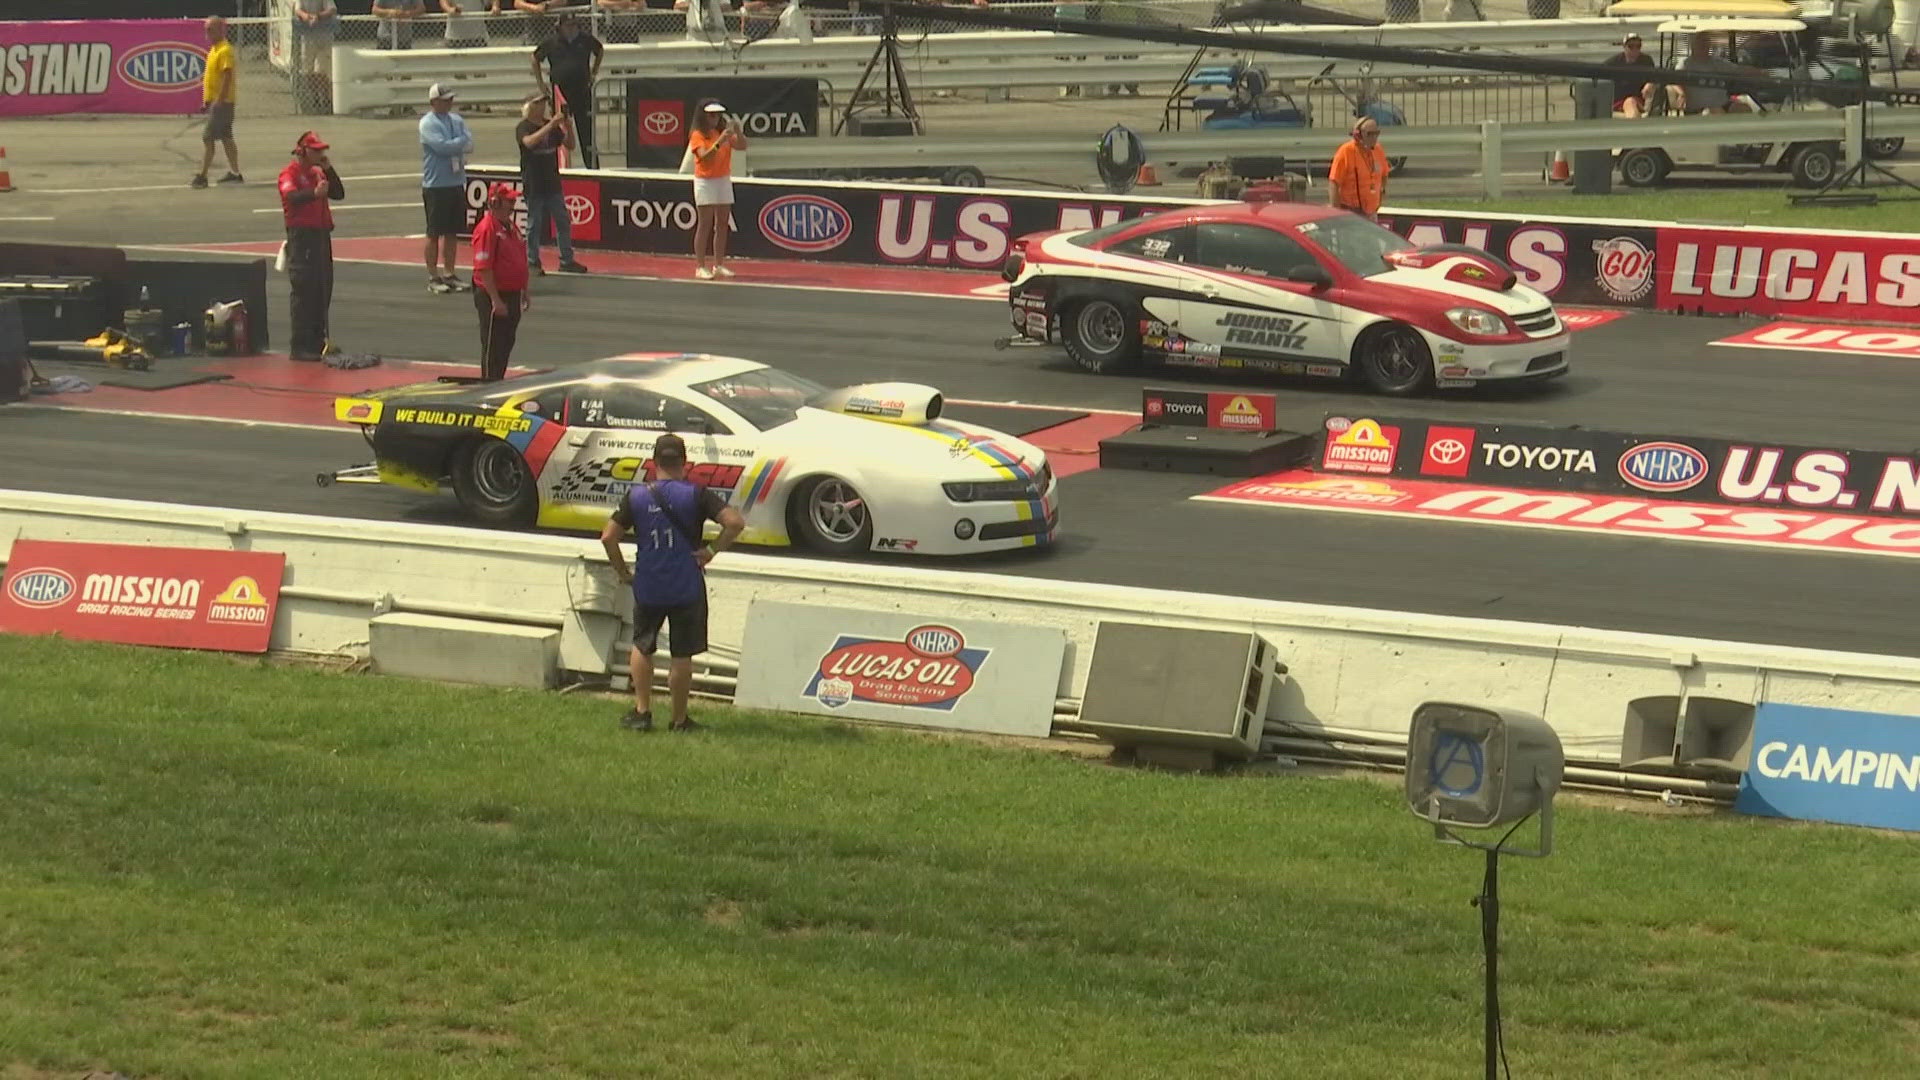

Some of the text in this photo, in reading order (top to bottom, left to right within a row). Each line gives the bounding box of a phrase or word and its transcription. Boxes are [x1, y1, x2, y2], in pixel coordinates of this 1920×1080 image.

[0, 43, 112, 96] STAND
[133, 51, 202, 83] NHRA
[773, 203, 840, 240] NHRA
[1604, 250, 1655, 279] GO!
[1671, 242, 1920, 308] LUCAS
[1225, 327, 1308, 350] FRANTZ
[395, 409, 532, 432] WE BUILD IT BETTER
[1165, 403, 1204, 415] TOYOTA
[1330, 445, 1390, 464] MISSION
[1482, 442, 1597, 473] TOYOTA
[1631, 451, 1695, 481] NHRA
[1719, 448, 1857, 506] U.S.
[553, 491, 607, 503] ALUMINUM
[650, 529, 674, 549] 11
[17, 574, 65, 601] NHRA
[82, 573, 202, 608] MISSION
[76, 603, 196, 620] DRAG RACING SERIES
[210, 604, 265, 622] MISSION
[914, 631, 956, 653] NHRA
[829, 652, 961, 687] LUCAS OIL
[859, 679, 894, 692] Drag
[898, 683, 947, 696] Racing
[874, 690, 920, 702] Series
[1757, 741, 1920, 792] CAMPIN
